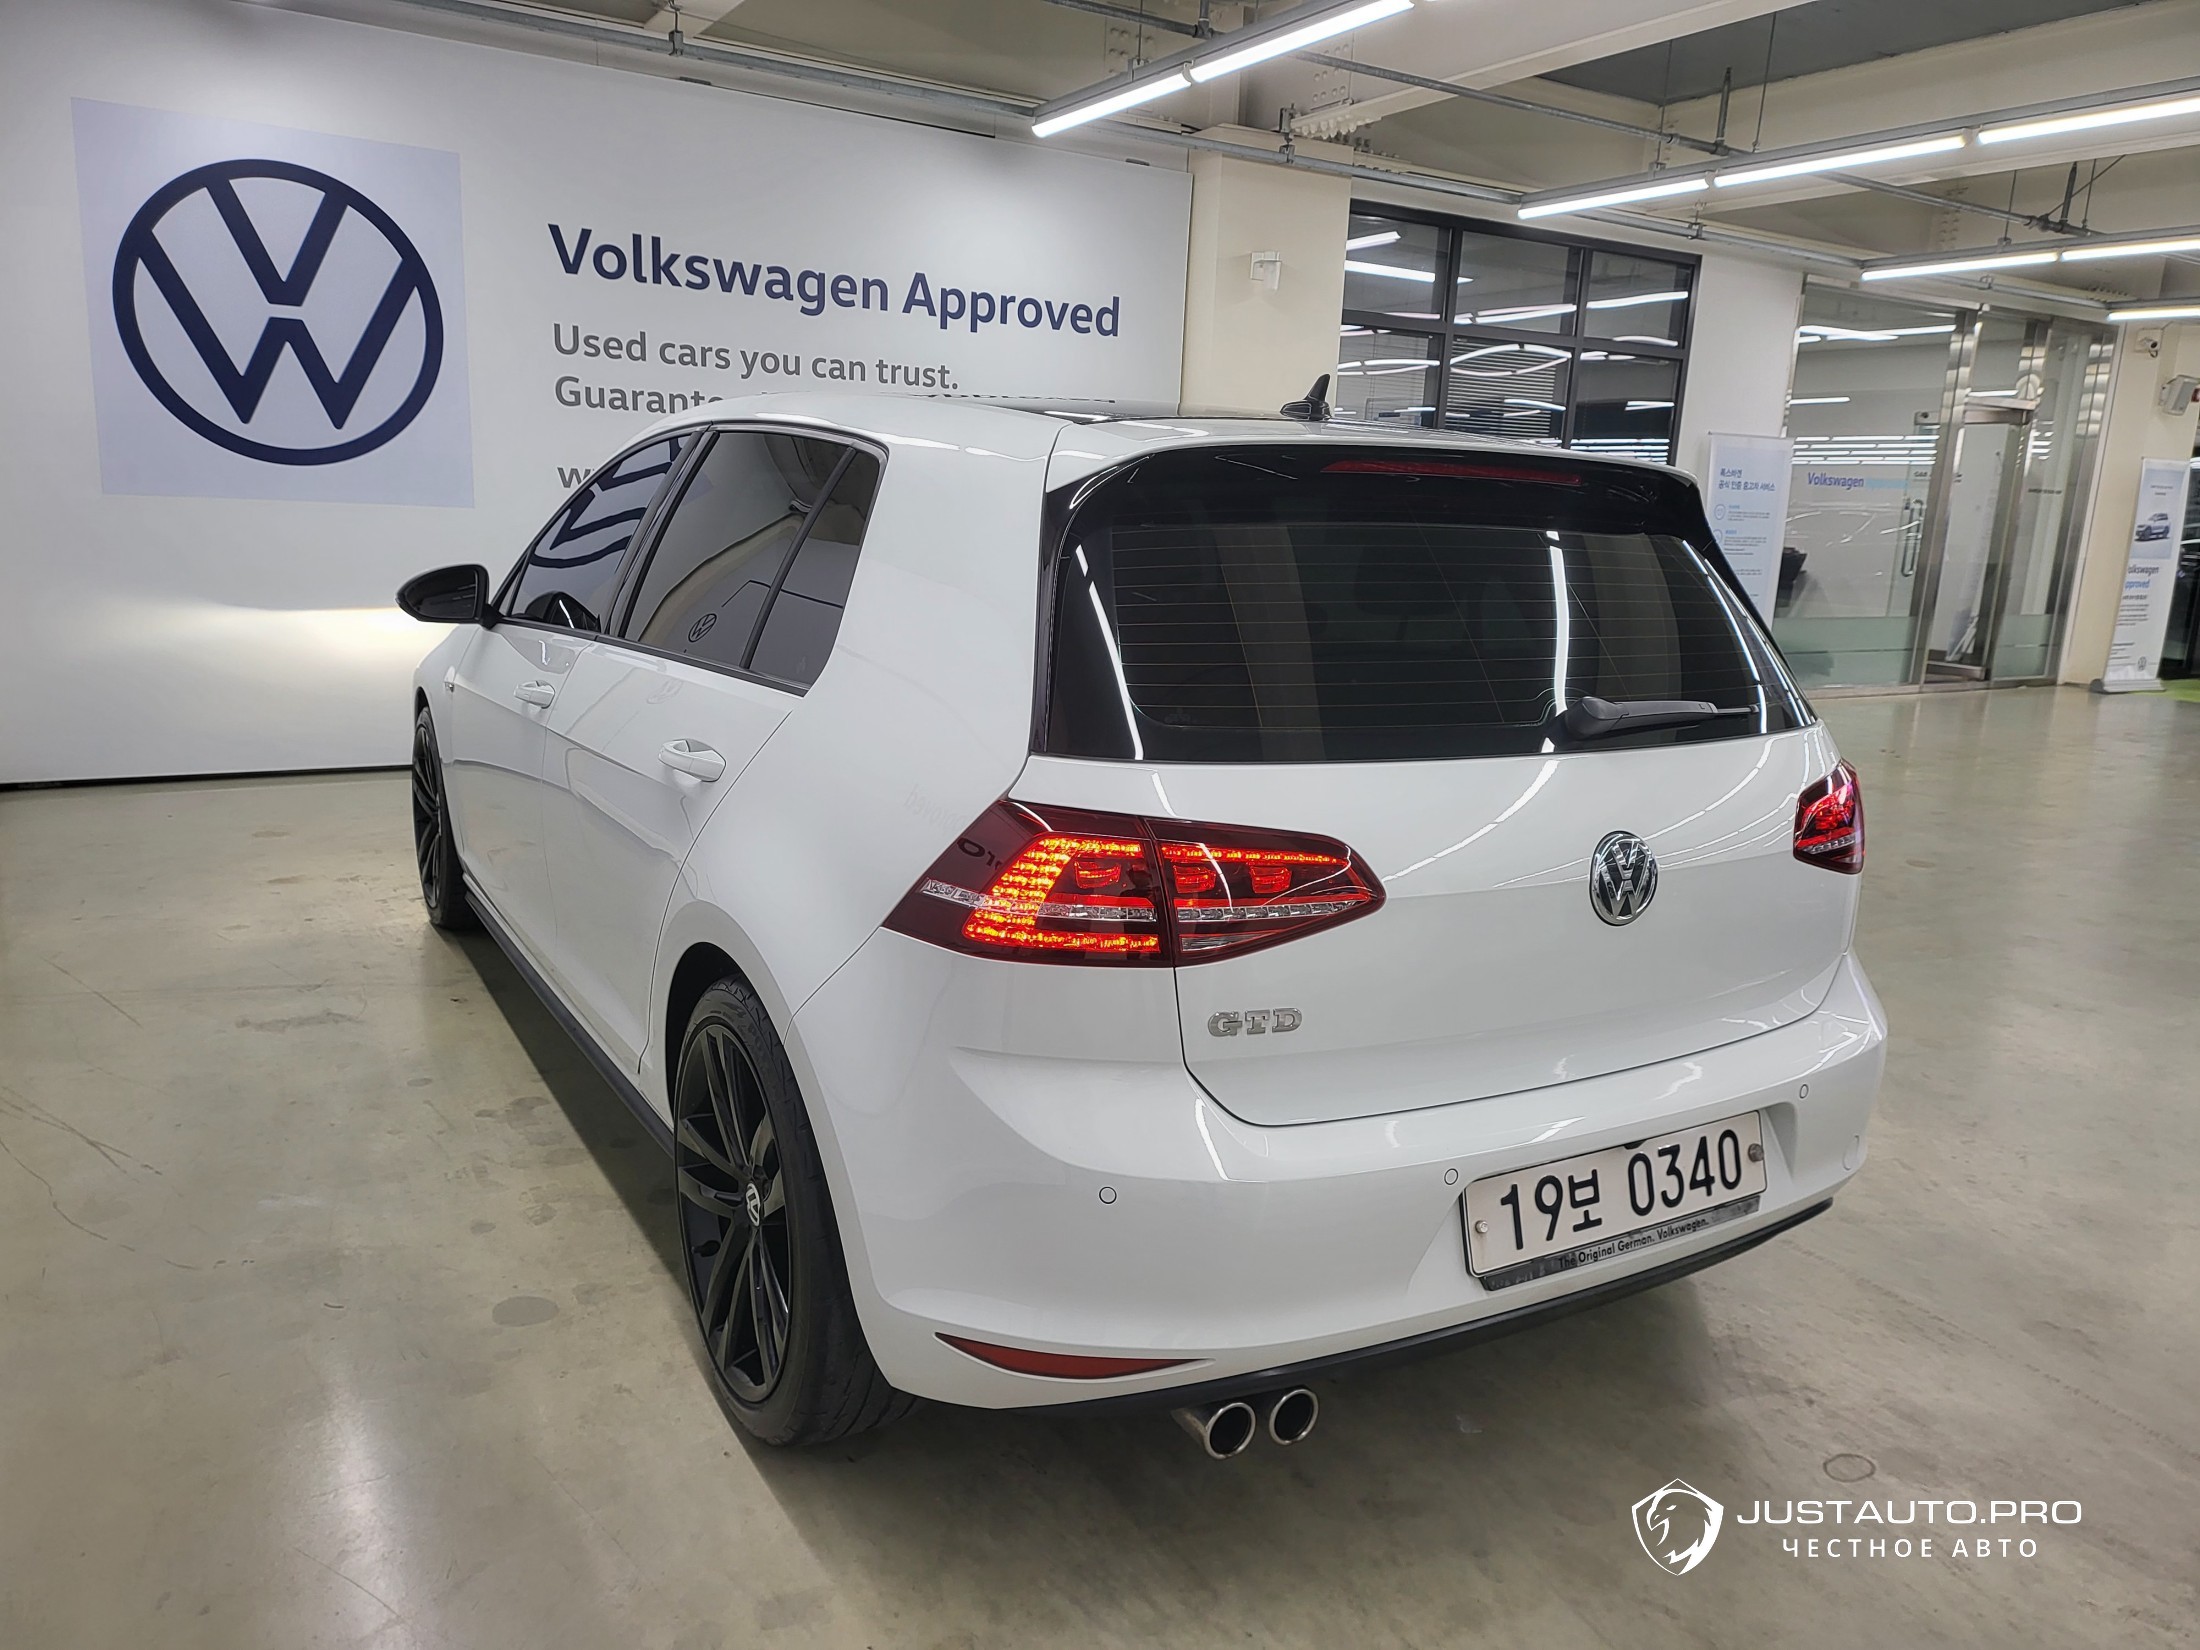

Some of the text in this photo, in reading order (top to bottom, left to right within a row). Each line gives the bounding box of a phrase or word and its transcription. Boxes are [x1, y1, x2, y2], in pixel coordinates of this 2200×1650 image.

[547, 222, 1120, 338] Volkswagen Approved
[553, 322, 958, 390] Used cars you can trust.
[1807, 472, 1865, 490] Volkswagen
[1207, 1007, 1303, 1038] GTD
[1500, 1128, 1742, 1250] 19보 0340
[1558, 1217, 1710, 1269] The Original German. Volkswagen.
